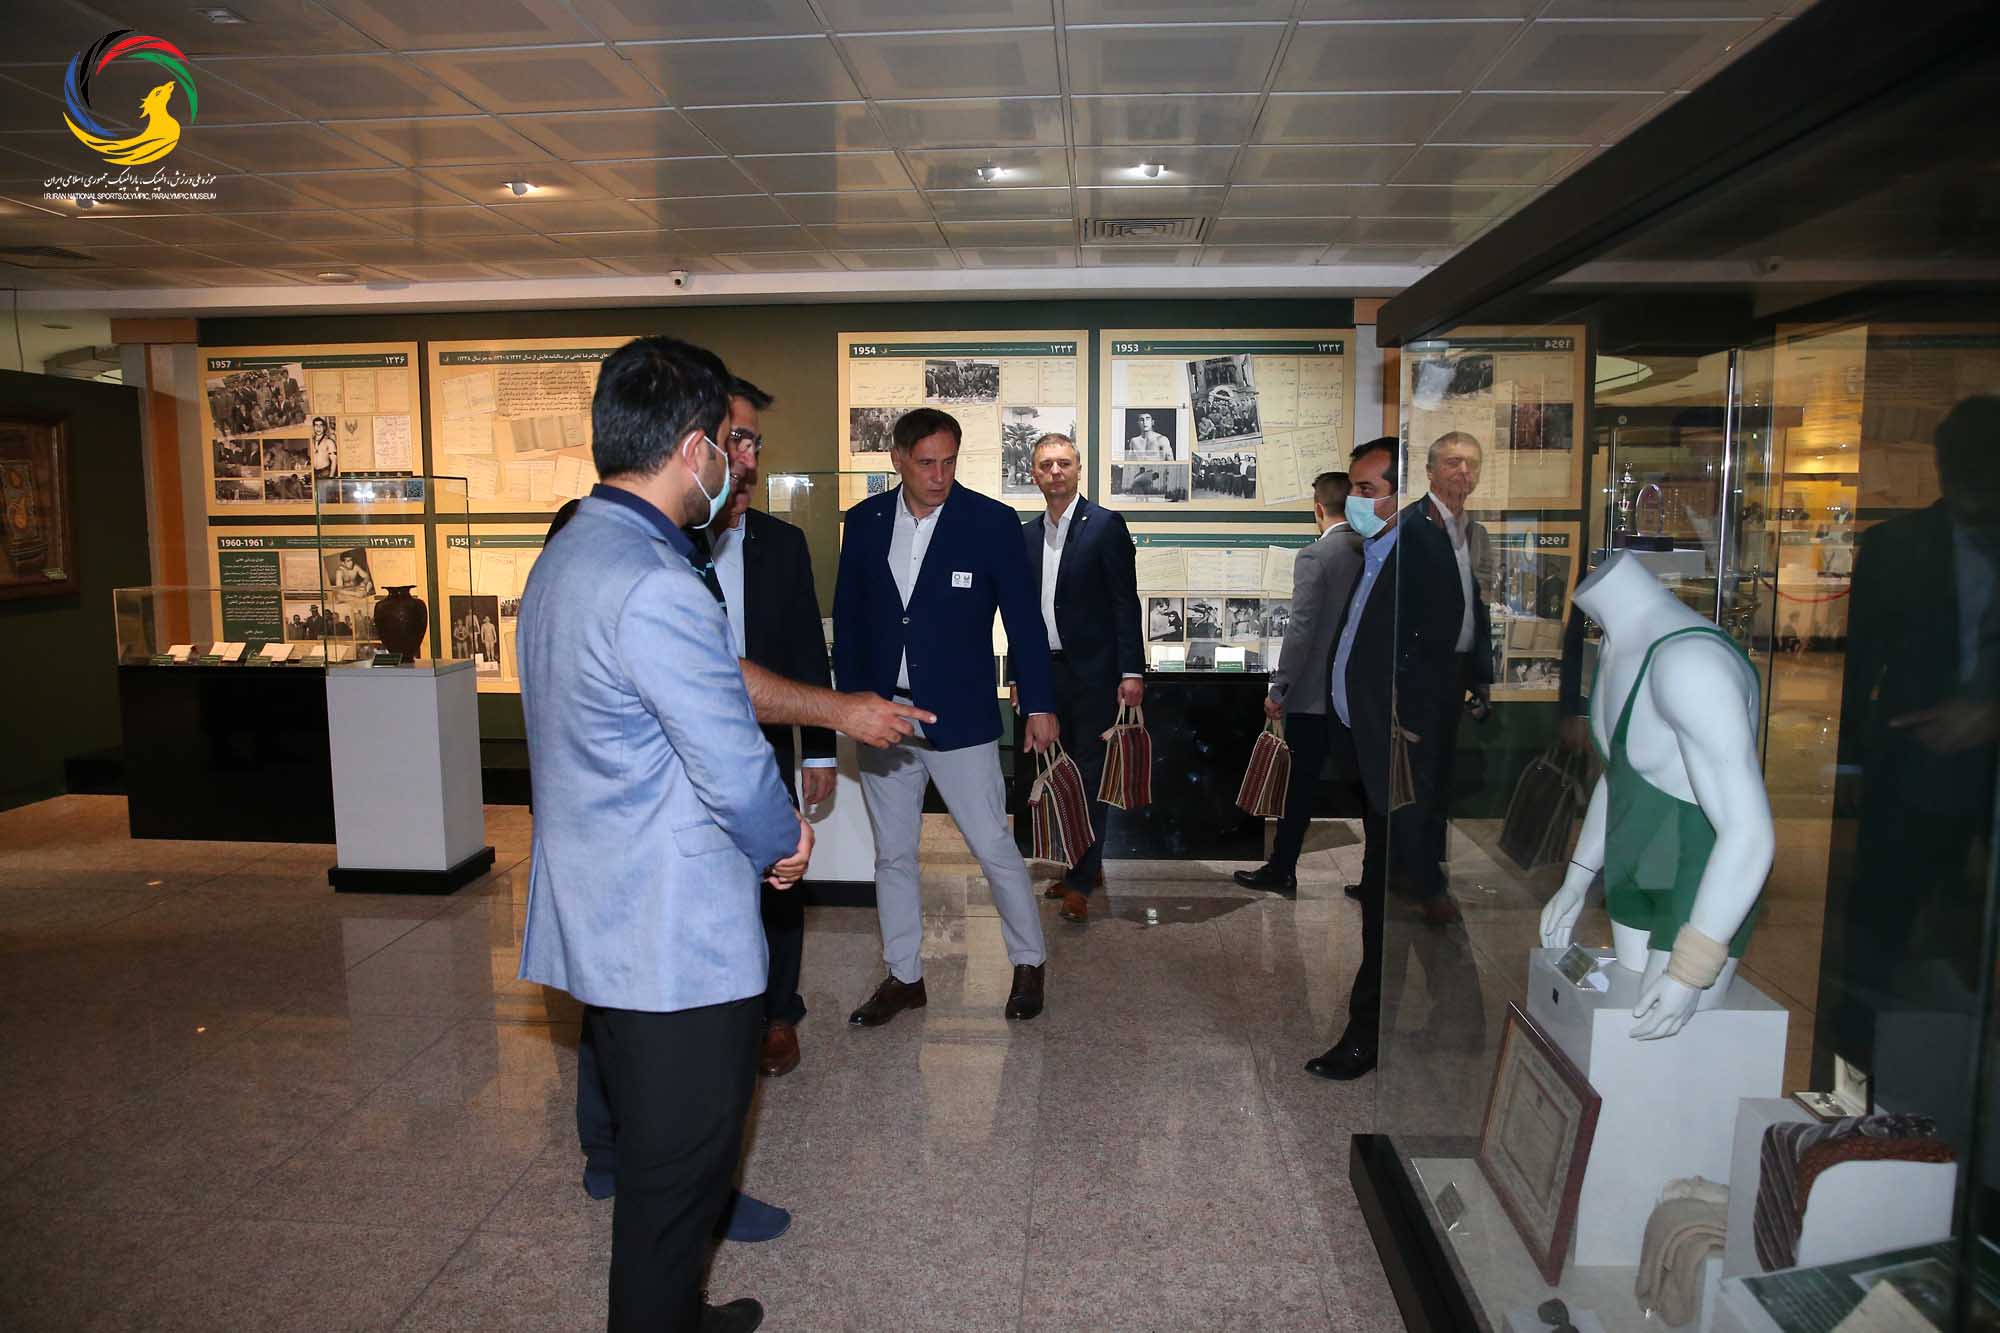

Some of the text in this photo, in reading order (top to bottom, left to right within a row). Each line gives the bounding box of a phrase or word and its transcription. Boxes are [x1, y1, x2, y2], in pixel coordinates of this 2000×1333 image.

[853, 346, 876, 355] 1954
[1115, 343, 1139, 353] 1953
[211, 360, 231, 369] 1957
[221, 539, 264, 547] 1960-1961
